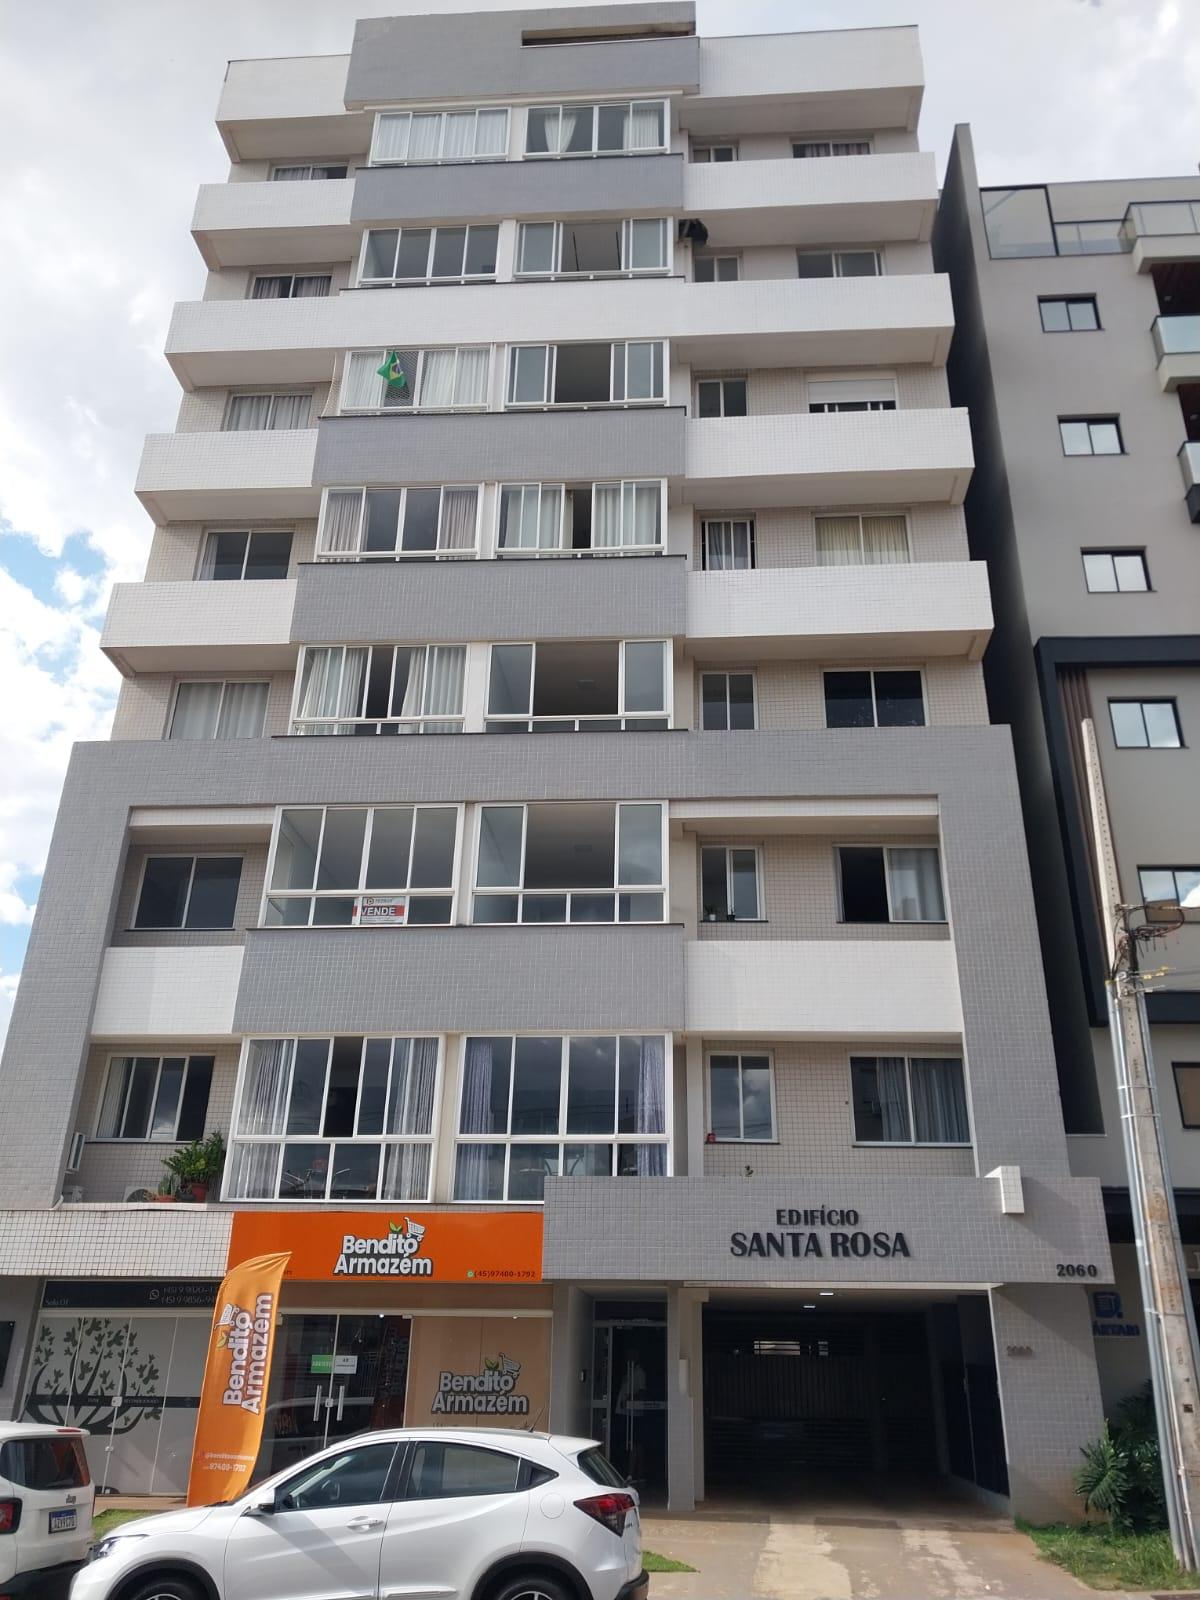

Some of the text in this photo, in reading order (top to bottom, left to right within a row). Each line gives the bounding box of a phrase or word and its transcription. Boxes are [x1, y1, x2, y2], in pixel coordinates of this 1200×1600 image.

[361, 907, 396, 916] VENDE
[776, 1204, 860, 1226] EDIFÍCIO
[342, 1232, 419, 1255] Bendito
[730, 1231, 911, 1258] SANTA ROSA
[1056, 1263, 1098, 1278] 2060
[222, 1311, 251, 1405] Bendito
[440, 1370, 515, 1392] Bendito
